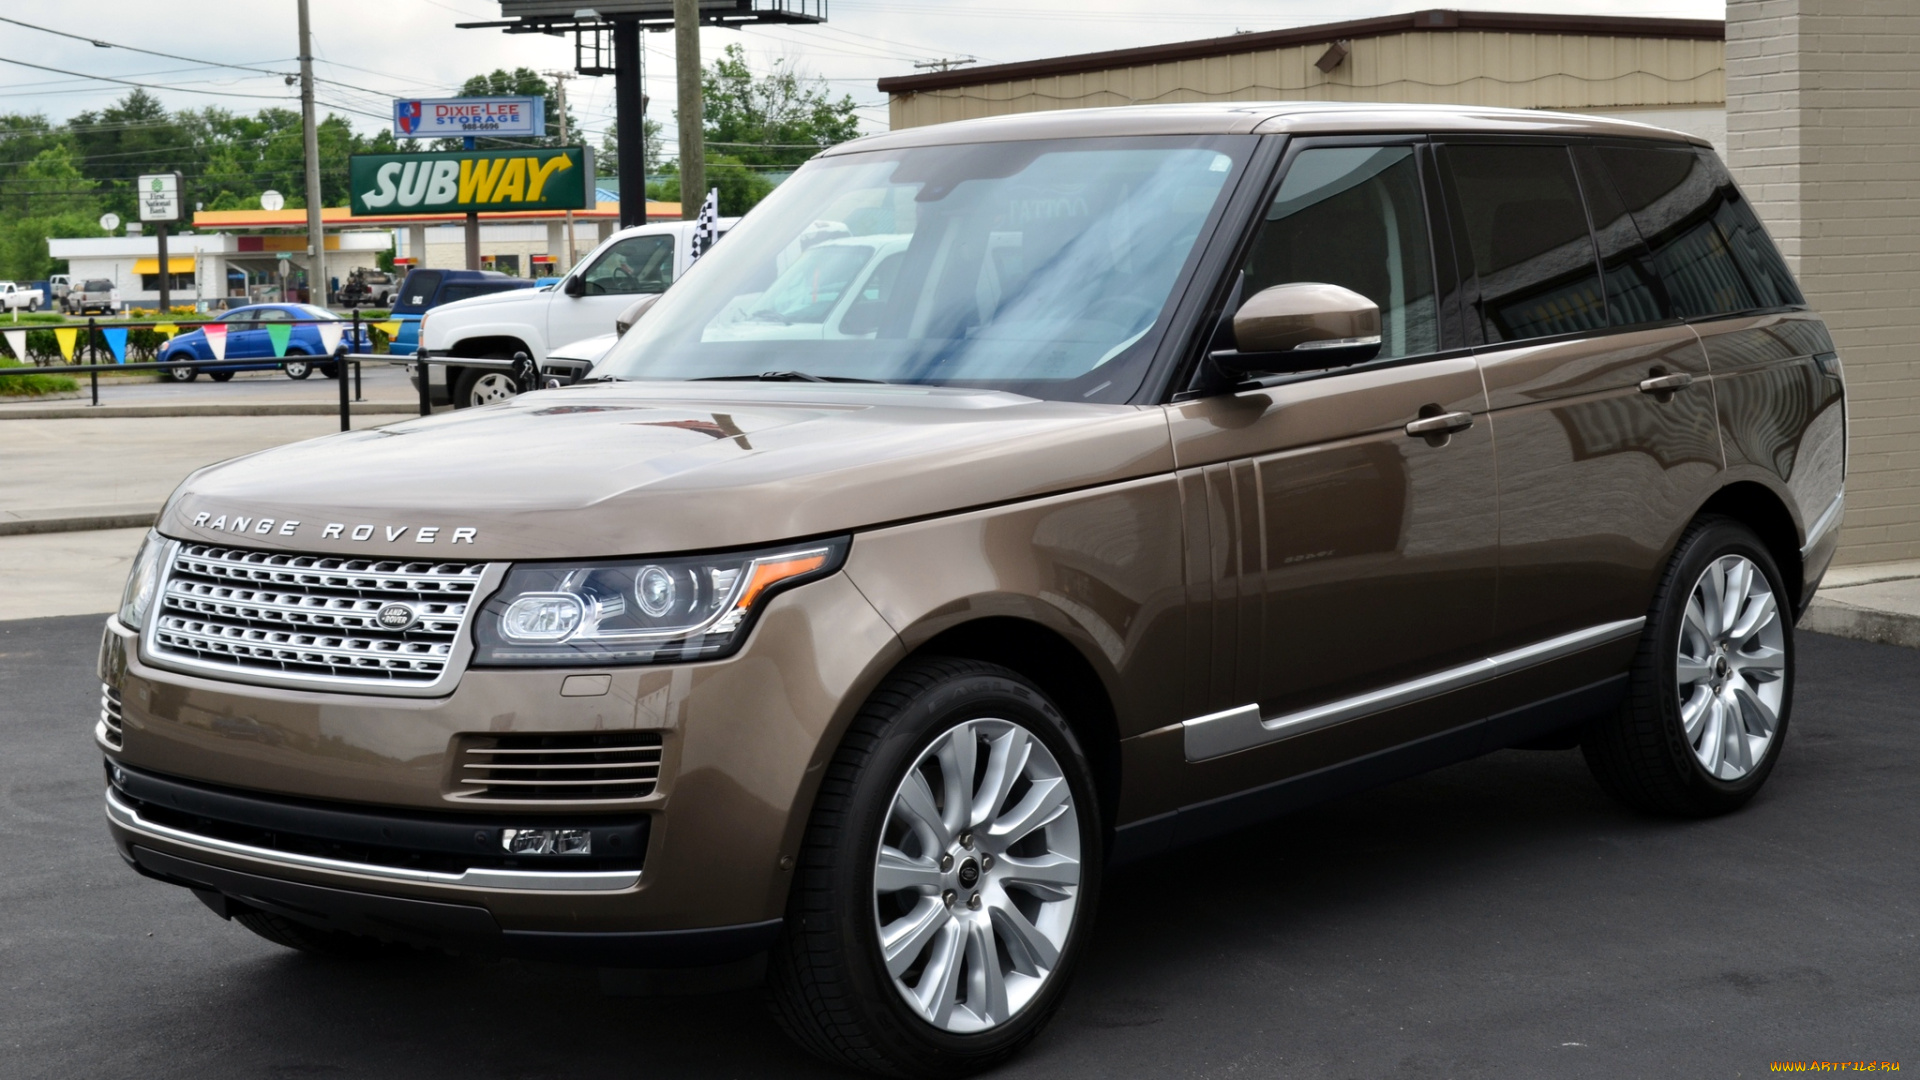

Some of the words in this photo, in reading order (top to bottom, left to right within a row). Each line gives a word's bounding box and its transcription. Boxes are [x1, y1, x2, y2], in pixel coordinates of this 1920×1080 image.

[436, 115, 520, 124] STORAGE
[361, 152, 572, 210] SUBWAY
[193, 511, 300, 536] RANGE
[321, 523, 477, 544] ROVER
[384, 608, 403, 616] LAND
[384, 616, 408, 624] ROVER
